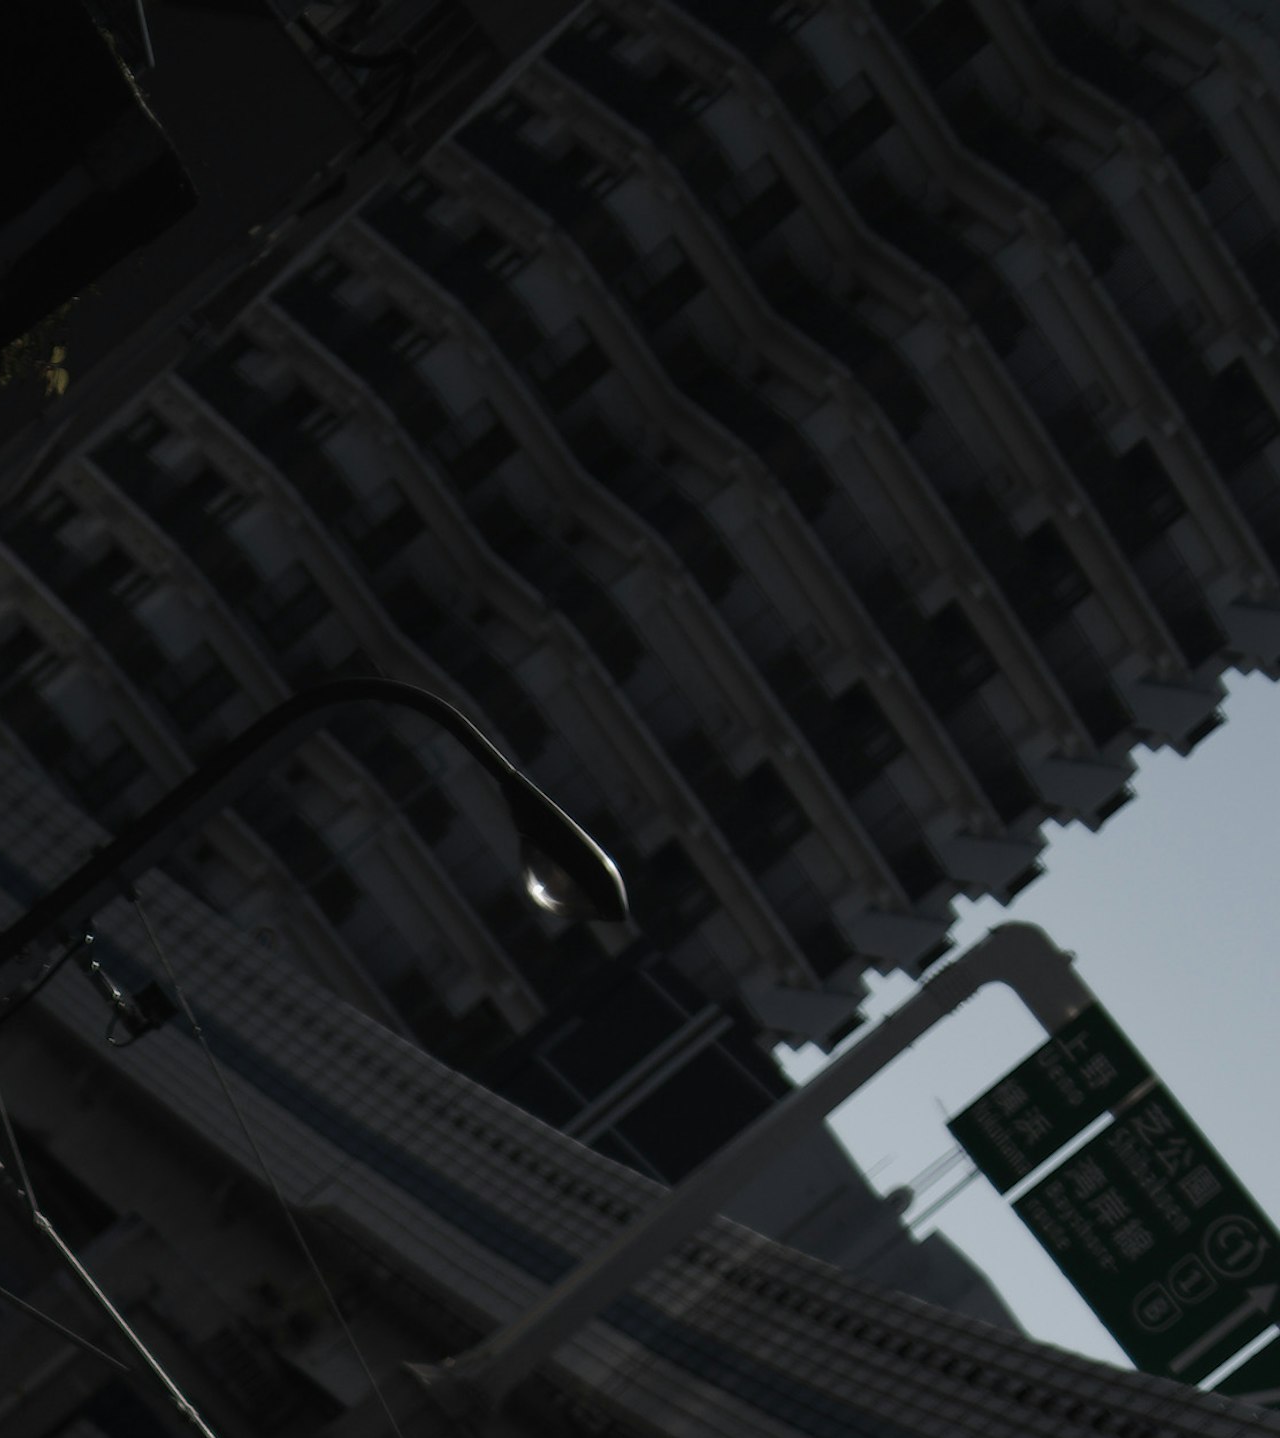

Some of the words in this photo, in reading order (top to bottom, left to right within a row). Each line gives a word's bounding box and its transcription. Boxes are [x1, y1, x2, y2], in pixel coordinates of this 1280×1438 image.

[1038, 1045, 1083, 1104] Ueno
[1057, 1029, 1118, 1089] 上野
[1129, 1101, 1223, 1210] 芝公園
[1217, 1223, 1254, 1268] C1
[1142, 1294, 1169, 1320] B
[1179, 1270, 1201, 1293] 1
